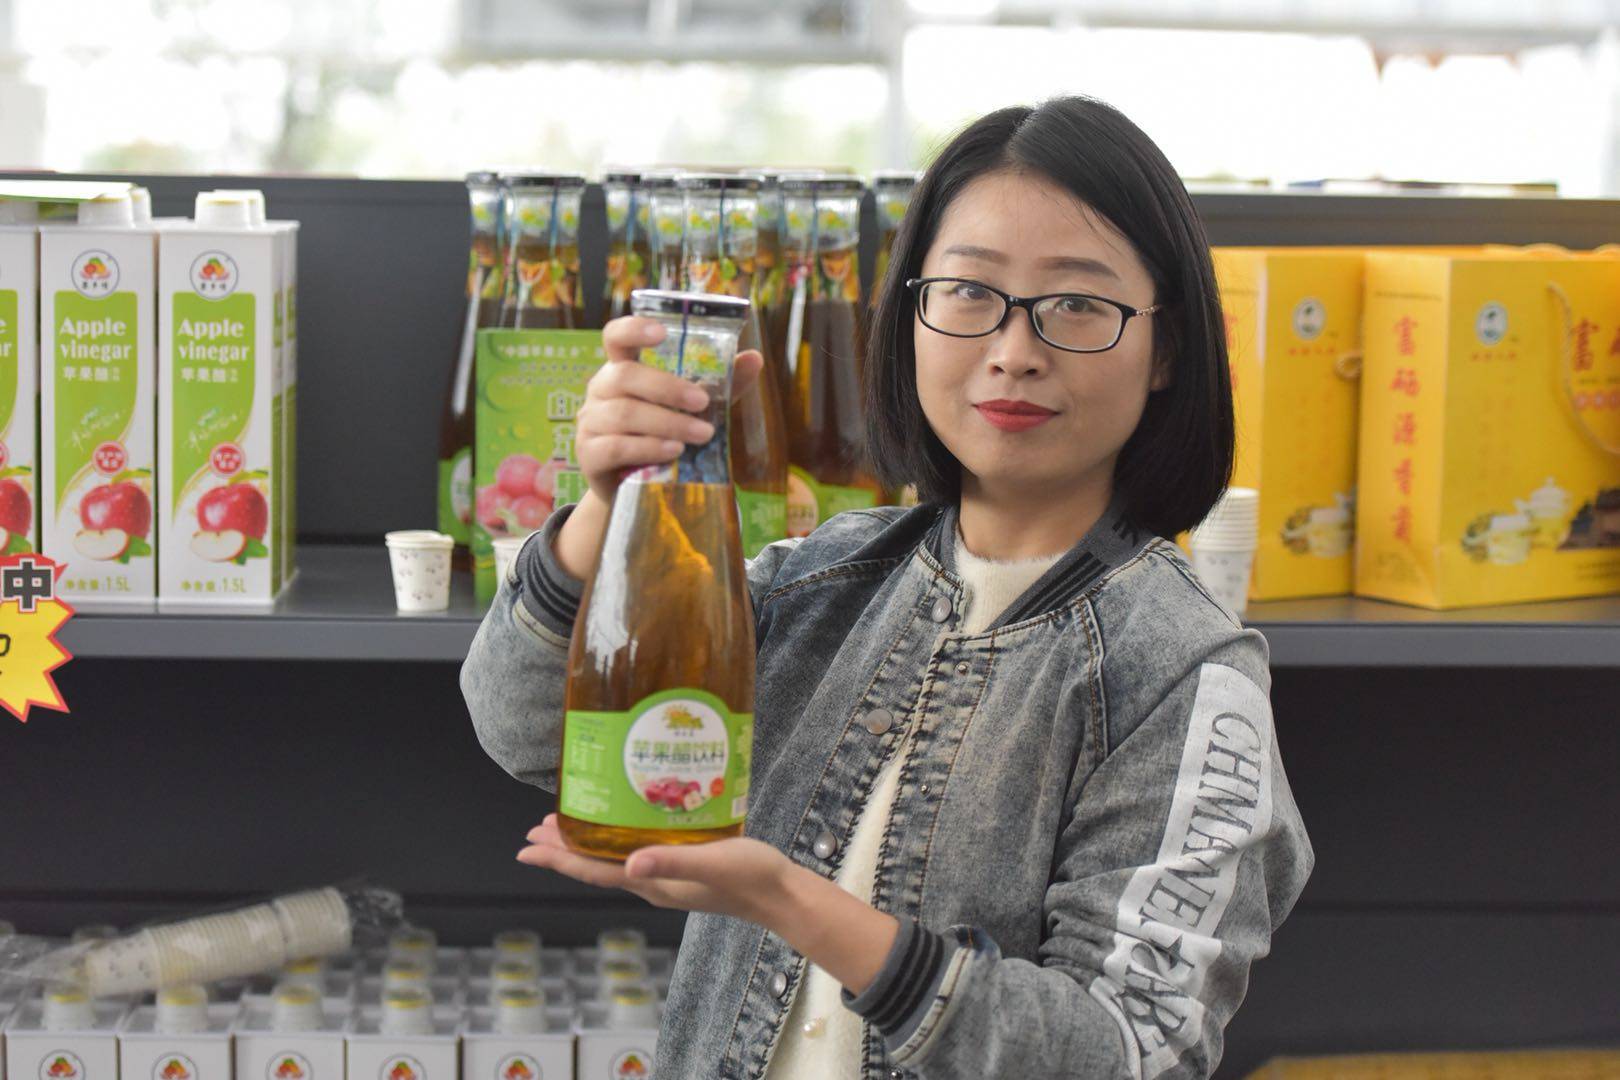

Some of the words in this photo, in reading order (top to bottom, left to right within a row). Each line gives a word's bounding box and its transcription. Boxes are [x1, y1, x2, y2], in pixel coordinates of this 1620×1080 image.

[59, 317, 127, 339] Apple
[177, 318, 244, 340] Apple
[60, 338, 132, 363] vinegar
[177, 341, 250, 365] vinegar
